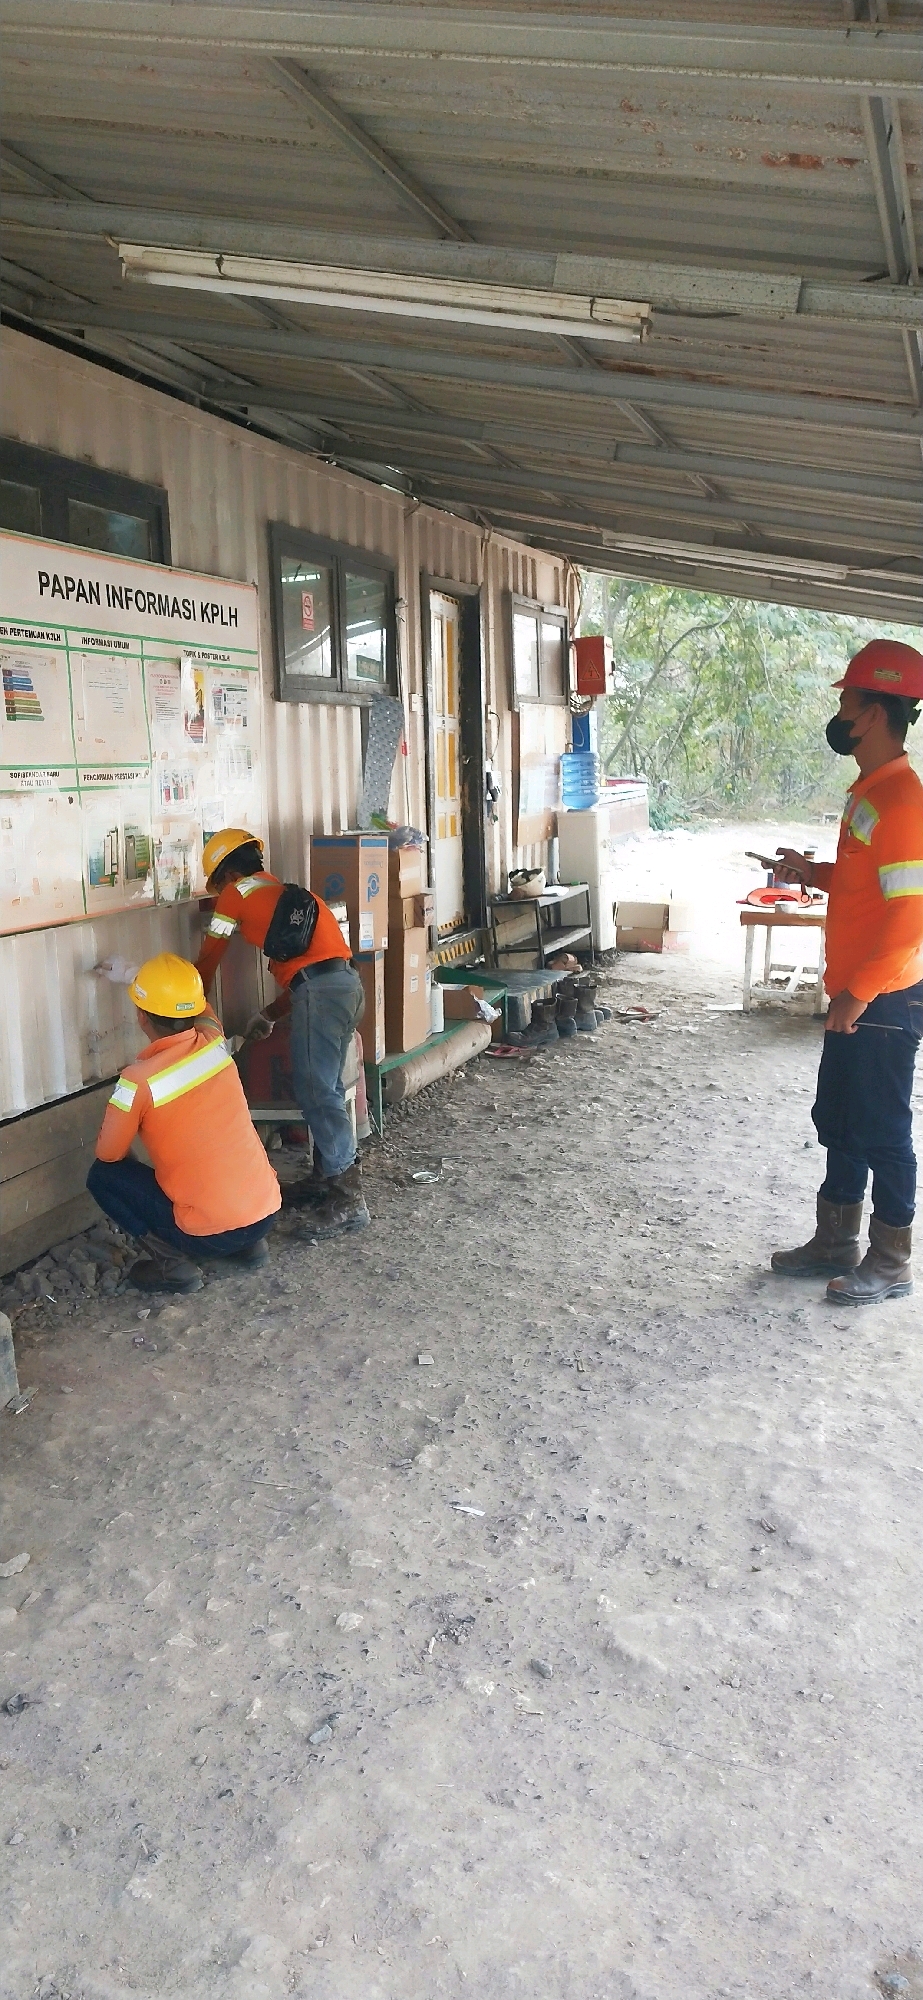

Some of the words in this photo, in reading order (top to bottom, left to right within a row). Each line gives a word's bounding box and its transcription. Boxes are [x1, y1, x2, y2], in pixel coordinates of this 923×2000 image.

[38, 571, 100, 605] PAPAN
[106, 584, 196, 621] INFORMASI
[200, 601, 239, 627] KPLH
[9, 627, 46, 640] PERTEMUAN
[81, 636, 113, 648] INFORMASI
[113, 640, 130, 650] UMUM
[183, 649, 197, 658] TOPIK
[201, 651, 219, 661] POSTER
[83, 773, 114, 782] PENCAPAIAN
[114, 772, 135, 781] PRESTASI
